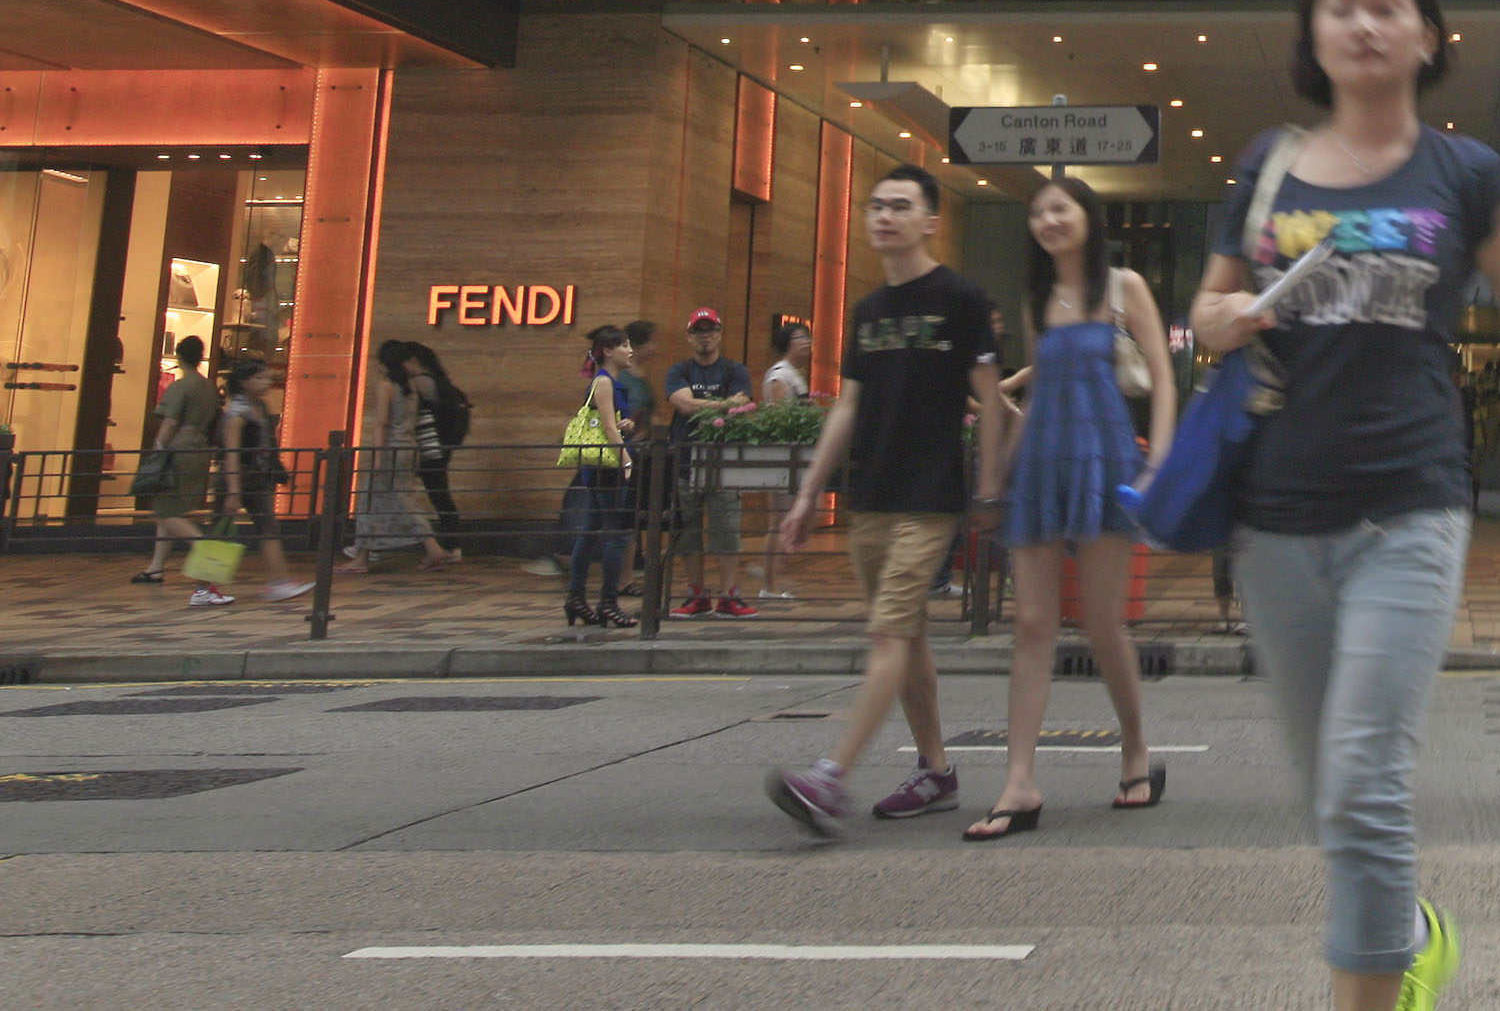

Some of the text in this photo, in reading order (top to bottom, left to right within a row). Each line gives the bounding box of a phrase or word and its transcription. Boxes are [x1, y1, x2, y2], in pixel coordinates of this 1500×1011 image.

[1001, 113, 1108, 129] Canton Road
[1018, 136, 1088, 157] 廣東道
[426, 284, 575, 326] FENDI
